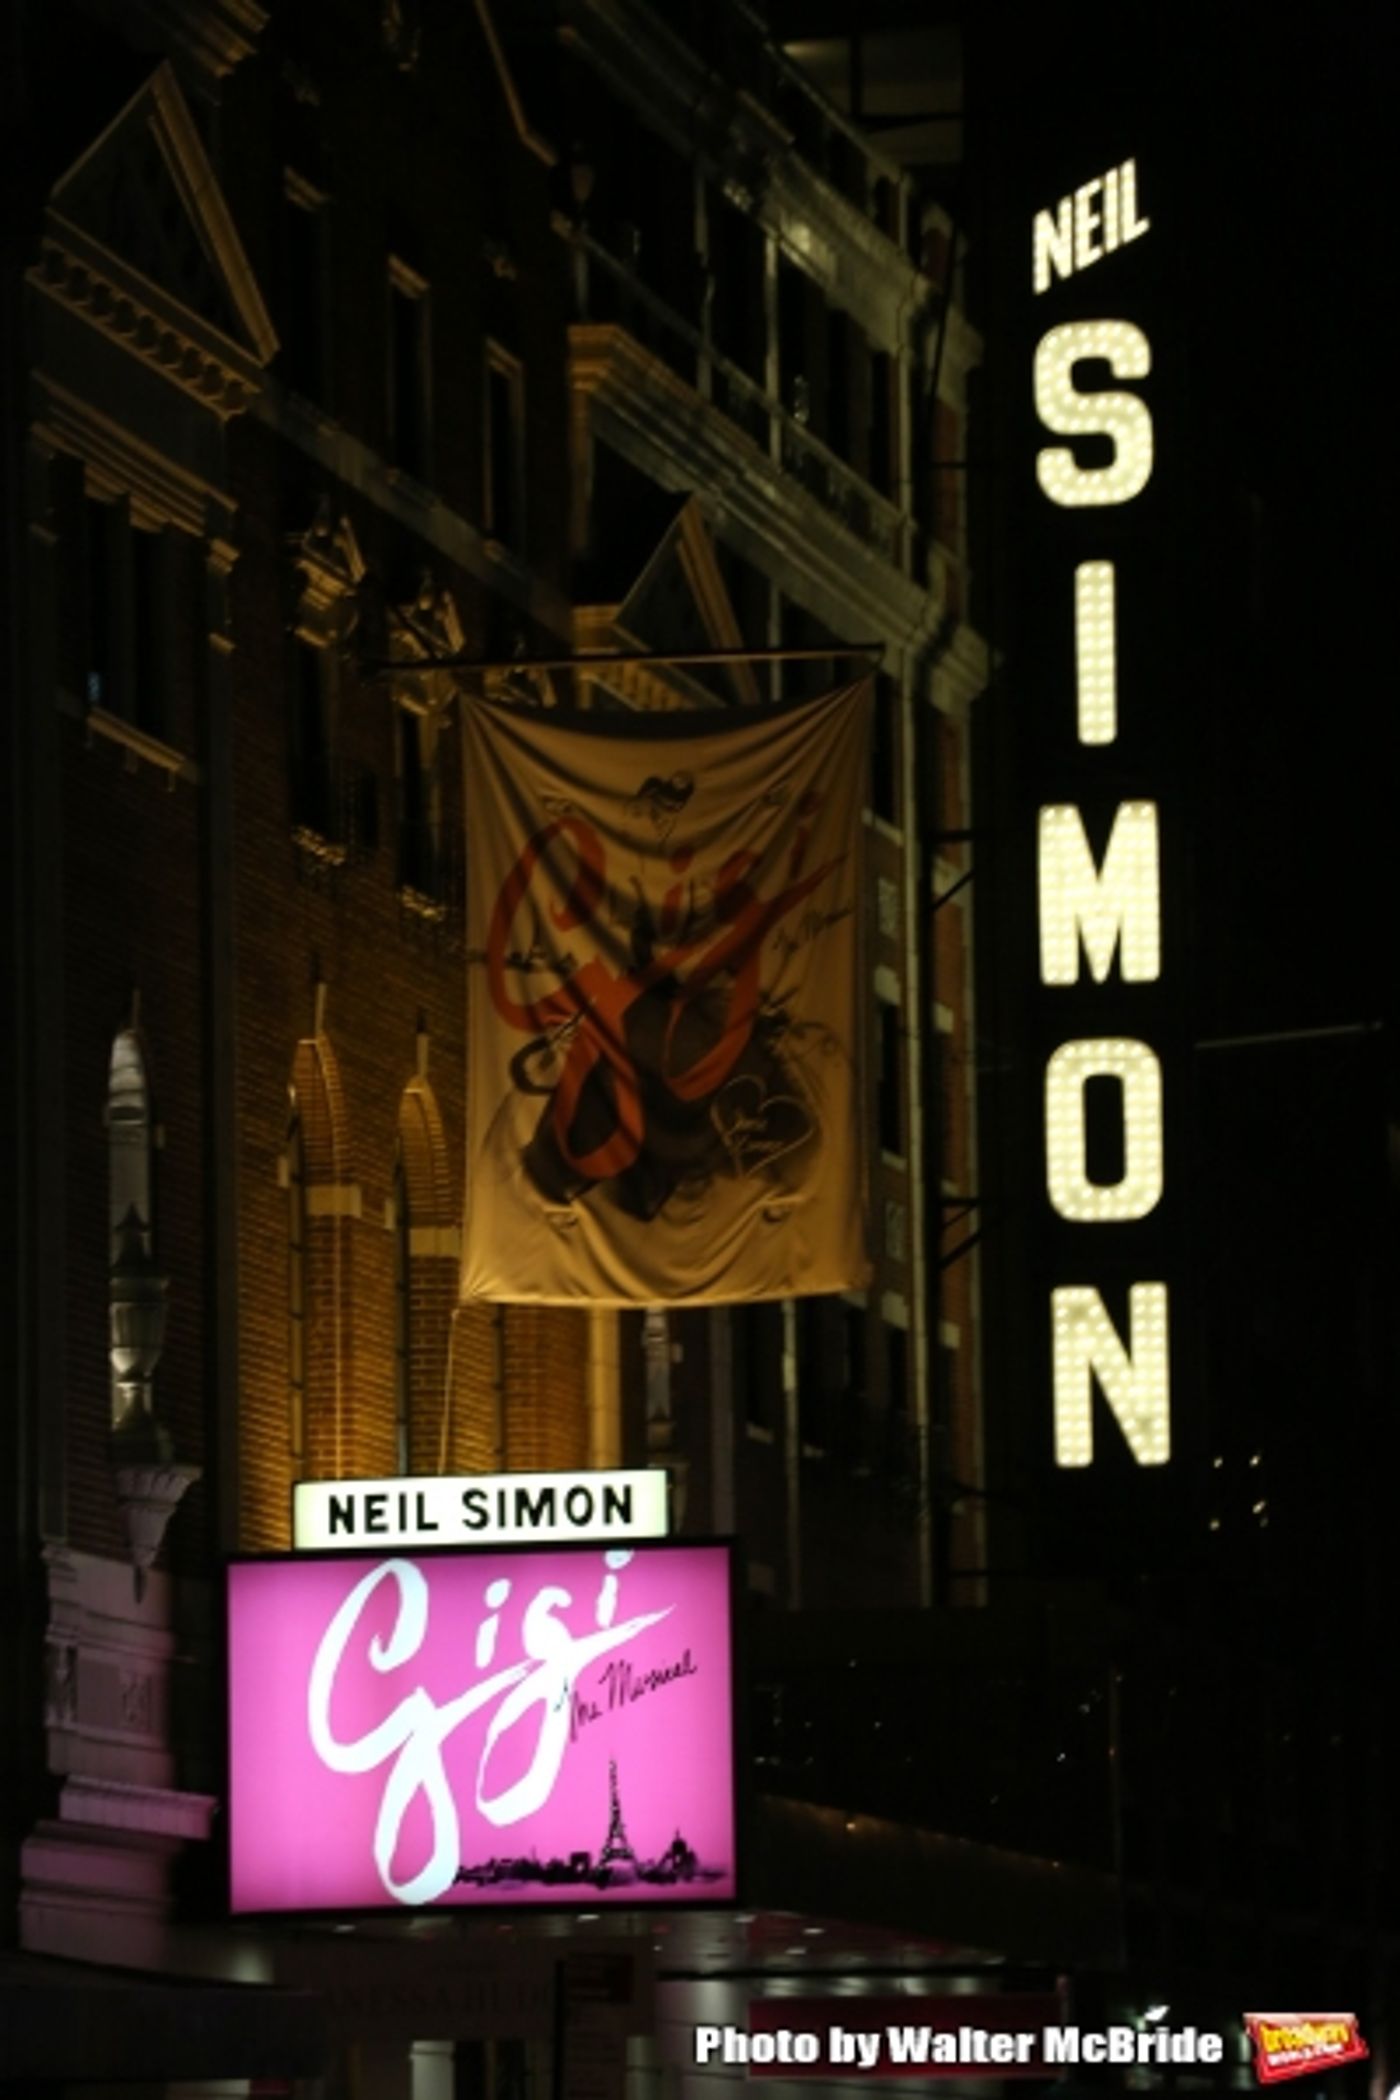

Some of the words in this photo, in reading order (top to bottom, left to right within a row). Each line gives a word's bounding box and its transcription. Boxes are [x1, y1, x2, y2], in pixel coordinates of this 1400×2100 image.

[1033, 158, 1150, 294] NEIL
[1033, 319, 1171, 1468] SIMON
[329, 1492, 439, 1535] NEIL
[462, 1484, 634, 1531] SIMON
[307, 1548, 678, 1905] Gigi
[598, 1648, 698, 1711] Musical
